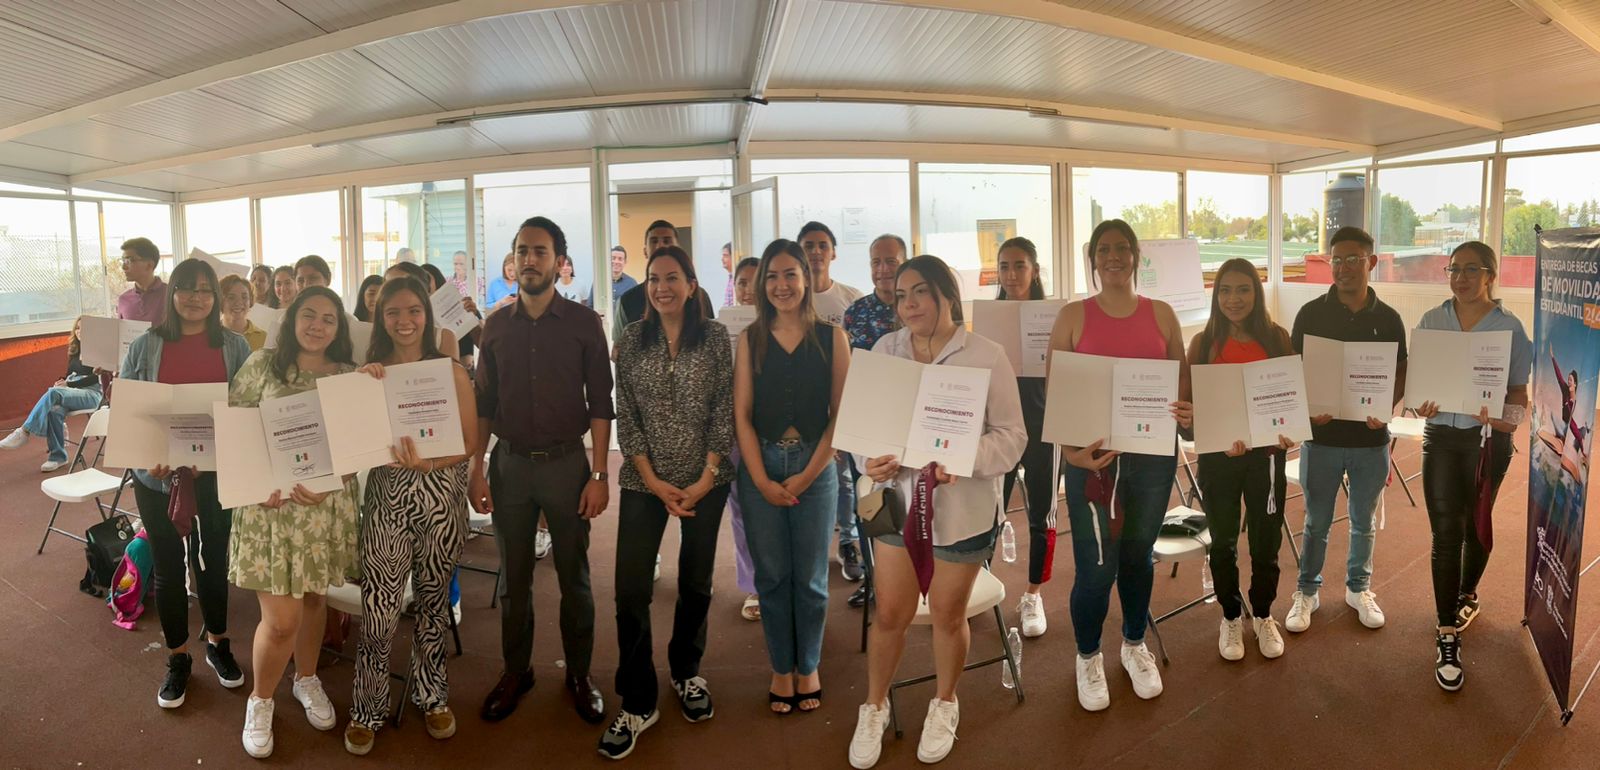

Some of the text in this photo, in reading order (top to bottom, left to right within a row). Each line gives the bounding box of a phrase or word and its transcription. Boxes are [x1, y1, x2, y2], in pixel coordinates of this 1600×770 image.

[1541, 259, 1598, 274] ENTREGA DE BECAS
[1541, 275, 1552, 292] DE
[1540, 298, 1583, 320] ESTUDIANTIL
[1253, 390, 1297, 401] RECONOCIMIENTO
[398, 399, 447, 409] RECONOCIMIENTO
[924, 406, 974, 417] RECONOCIMIENTO
[273, 422, 319, 437] RECONOCIMIENTO
